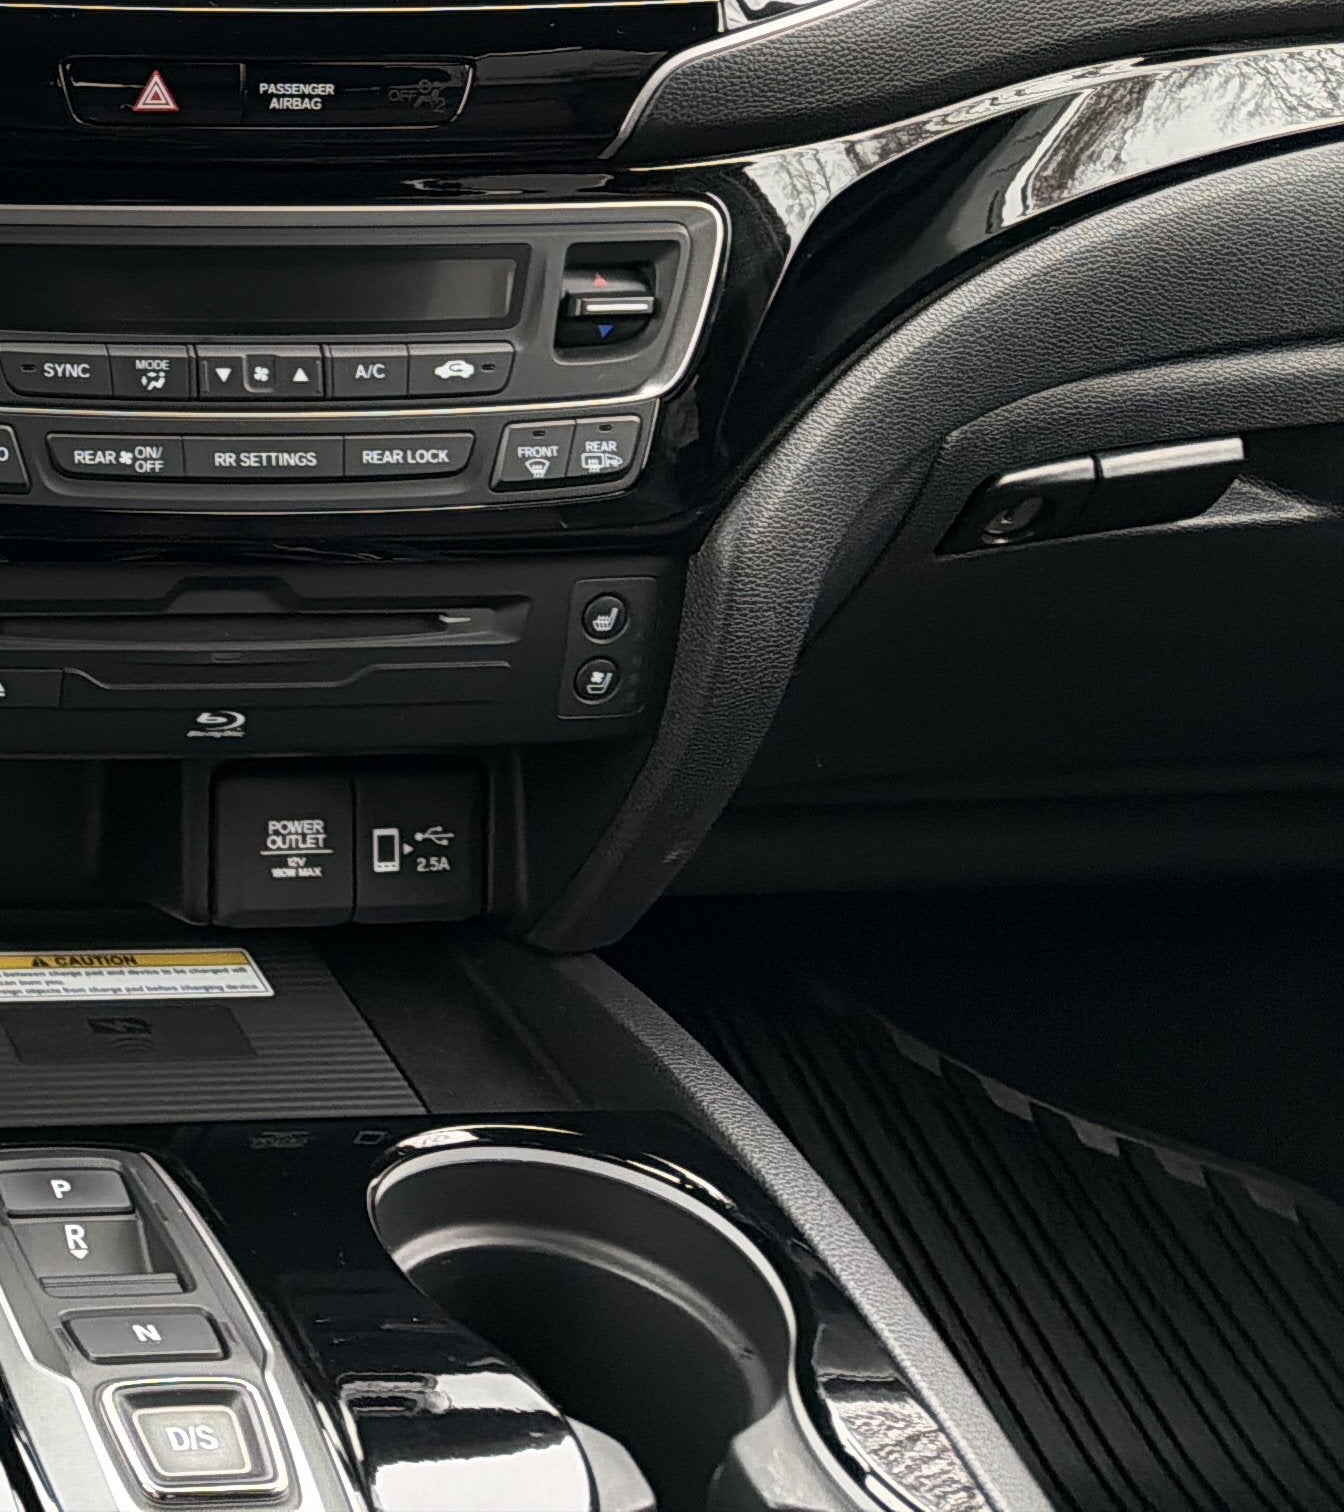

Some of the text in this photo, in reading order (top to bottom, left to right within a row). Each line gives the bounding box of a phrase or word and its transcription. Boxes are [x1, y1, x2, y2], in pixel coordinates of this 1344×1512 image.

[259, 82, 335, 96] PASSENGER
[269, 97, 323, 110] AIRBAG
[43, 363, 91, 378] SYNC
[135, 359, 170, 371] MODE
[355, 364, 386, 379] A/C
[134, 446, 163, 460] ON/
[517, 445, 559, 459] FRONT
[585, 440, 618, 453] REAR
[74, 450, 116, 465] REAR
[214, 452, 317, 467] RR SETTINGS
[362, 448, 450, 464] REAR LOCK
[134, 460, 164, 473] OFF
[268, 819, 325, 835] POWER
[266, 834, 327, 849] OUTLET
[416, 857, 452, 873] 2.5A
[54, 954, 138, 968] CAUTION
[50, 1179, 72, 1199] P
[64, 1223, 89, 1249] R
[131, 1324, 162, 1342] N
[164, 1425, 219, 1452] D/S
